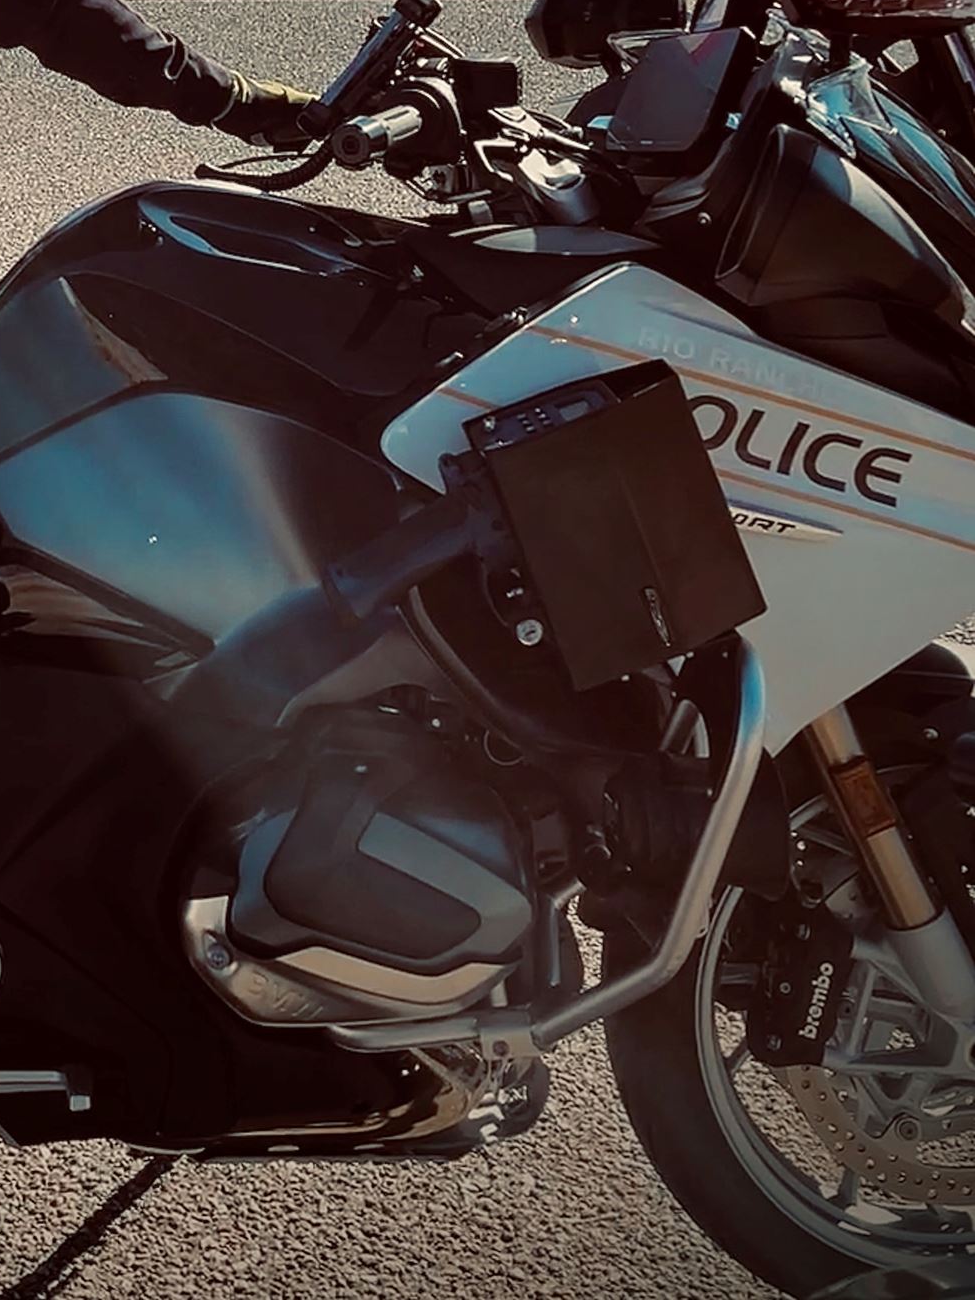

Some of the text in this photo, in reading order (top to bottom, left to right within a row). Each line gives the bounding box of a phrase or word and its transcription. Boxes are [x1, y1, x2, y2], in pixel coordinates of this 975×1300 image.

[637, 325, 696, 361] RIO
[686, 394, 914, 509] OLICE
[731, 512, 796, 533] ORT
